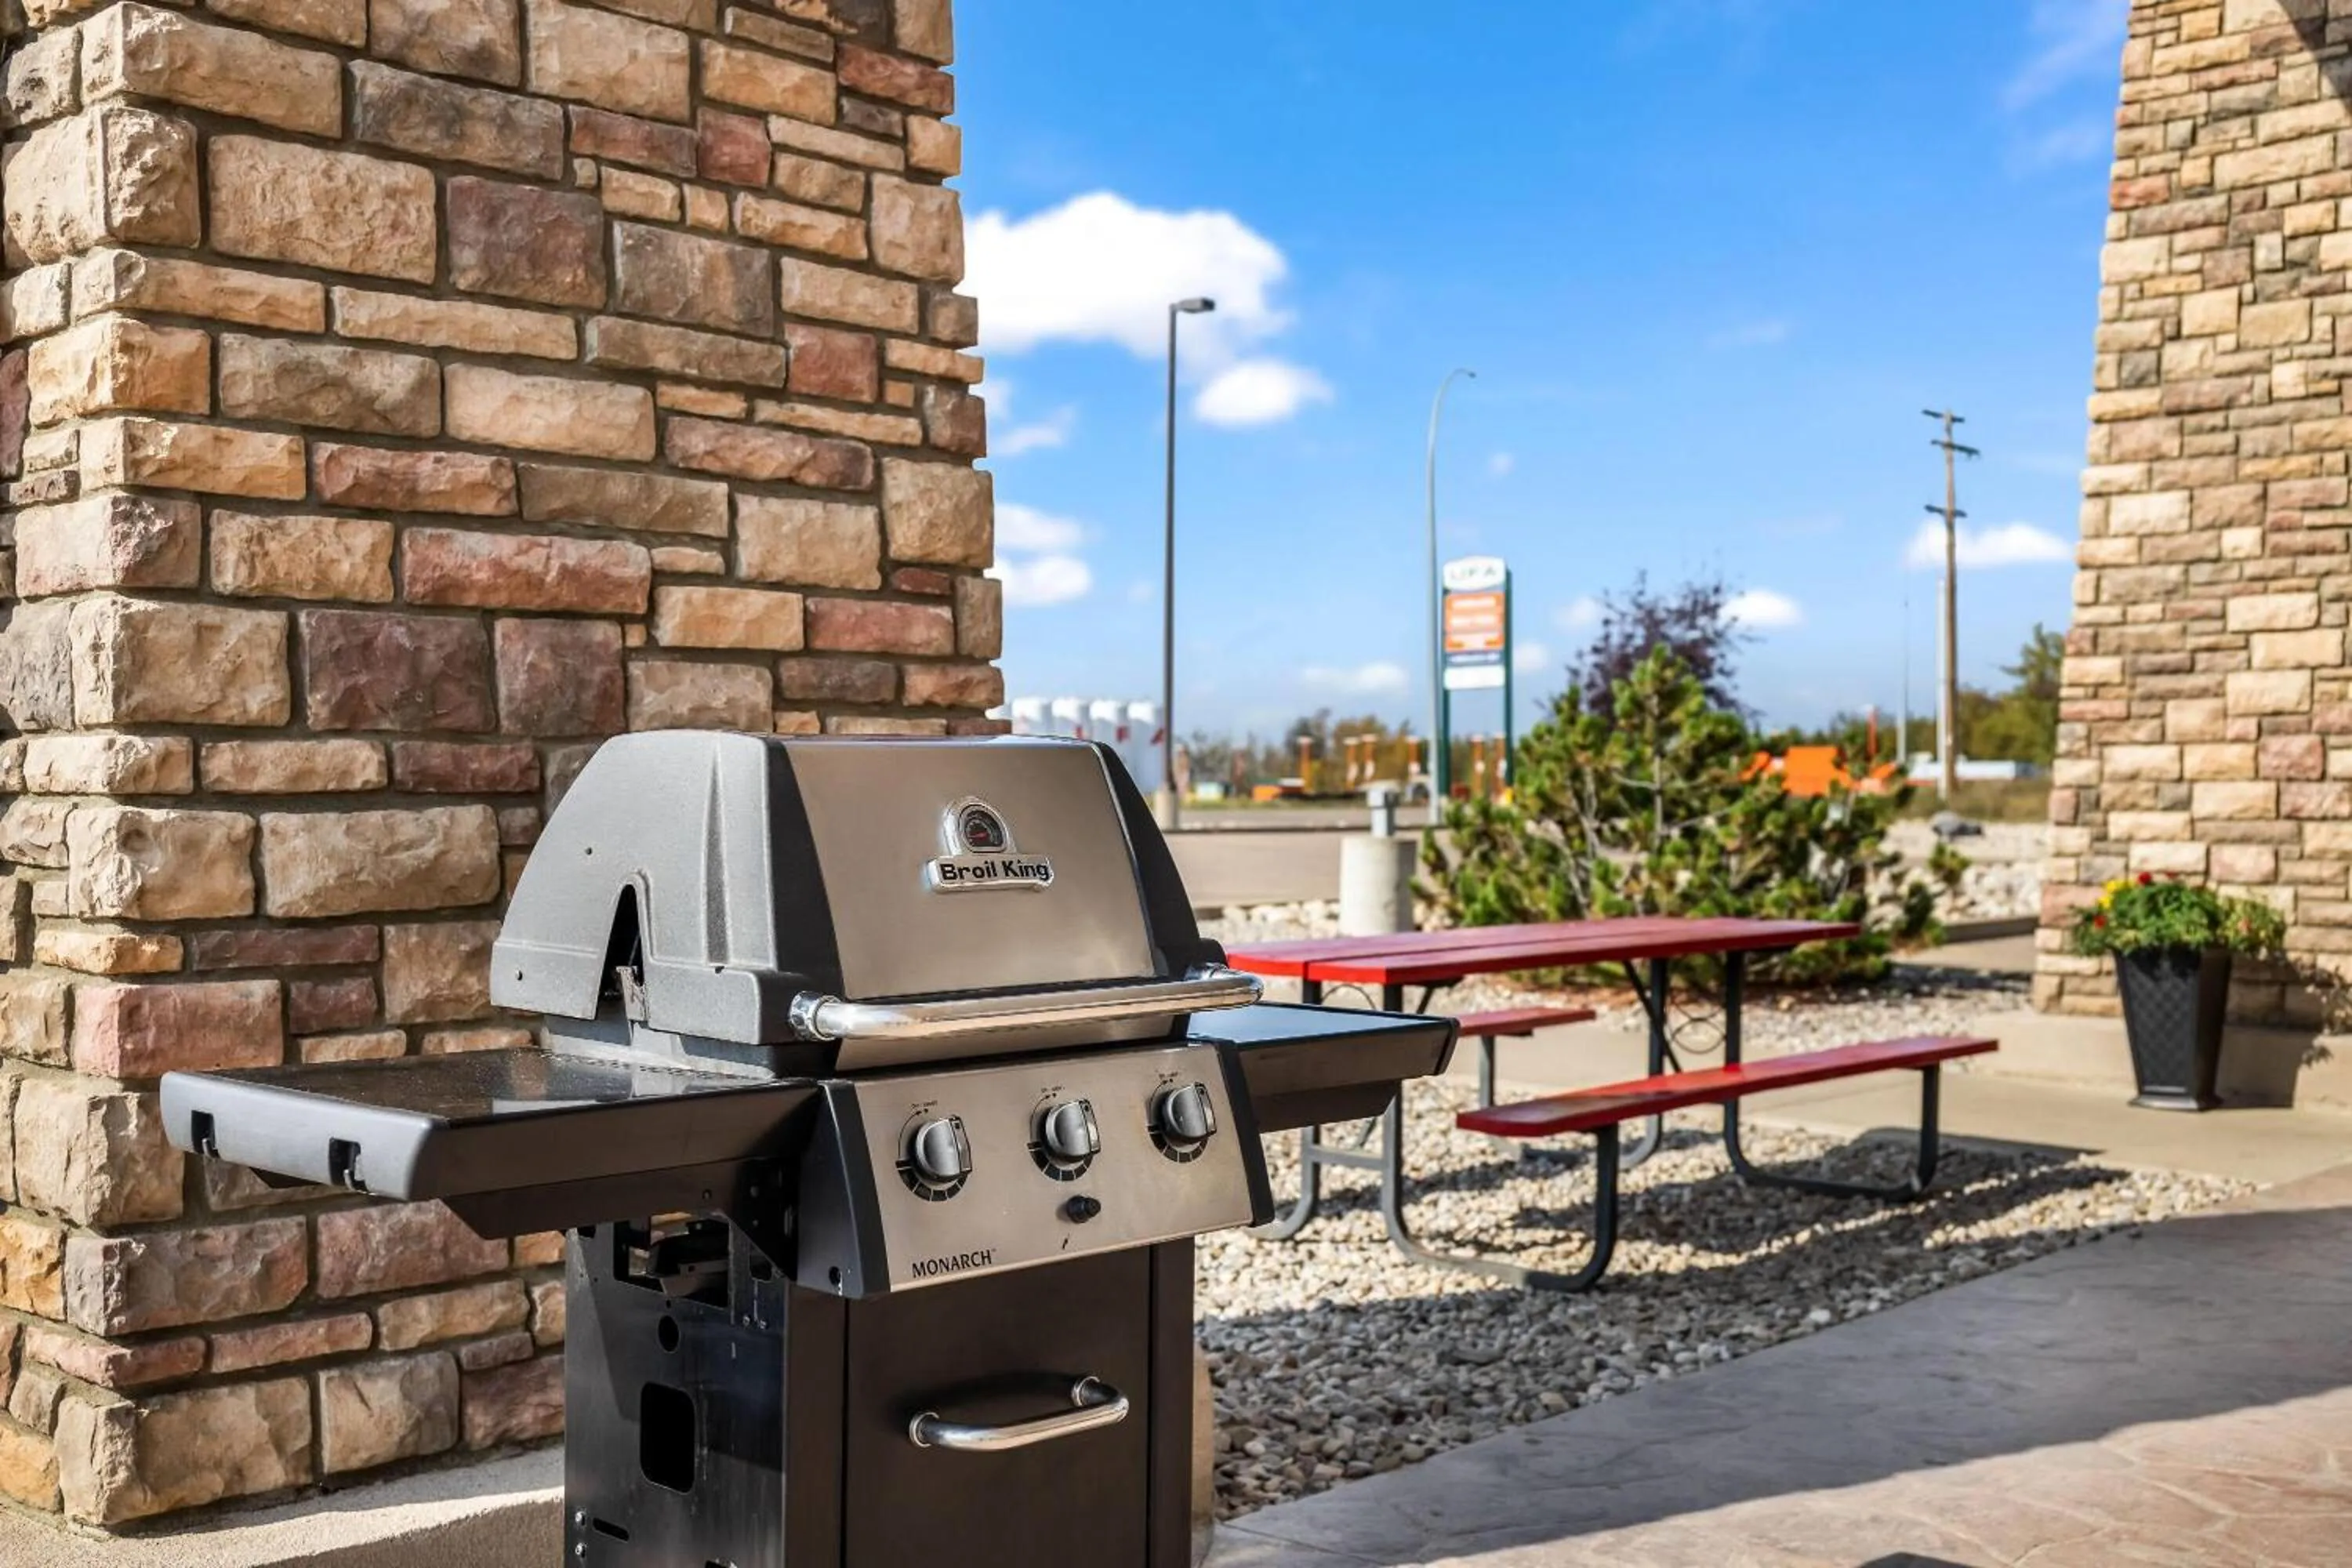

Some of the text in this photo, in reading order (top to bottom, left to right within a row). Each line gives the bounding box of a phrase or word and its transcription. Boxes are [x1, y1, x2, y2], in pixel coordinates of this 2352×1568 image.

[940, 859, 1049, 881] Broil King
[912, 1250, 992, 1279] MONARCH
